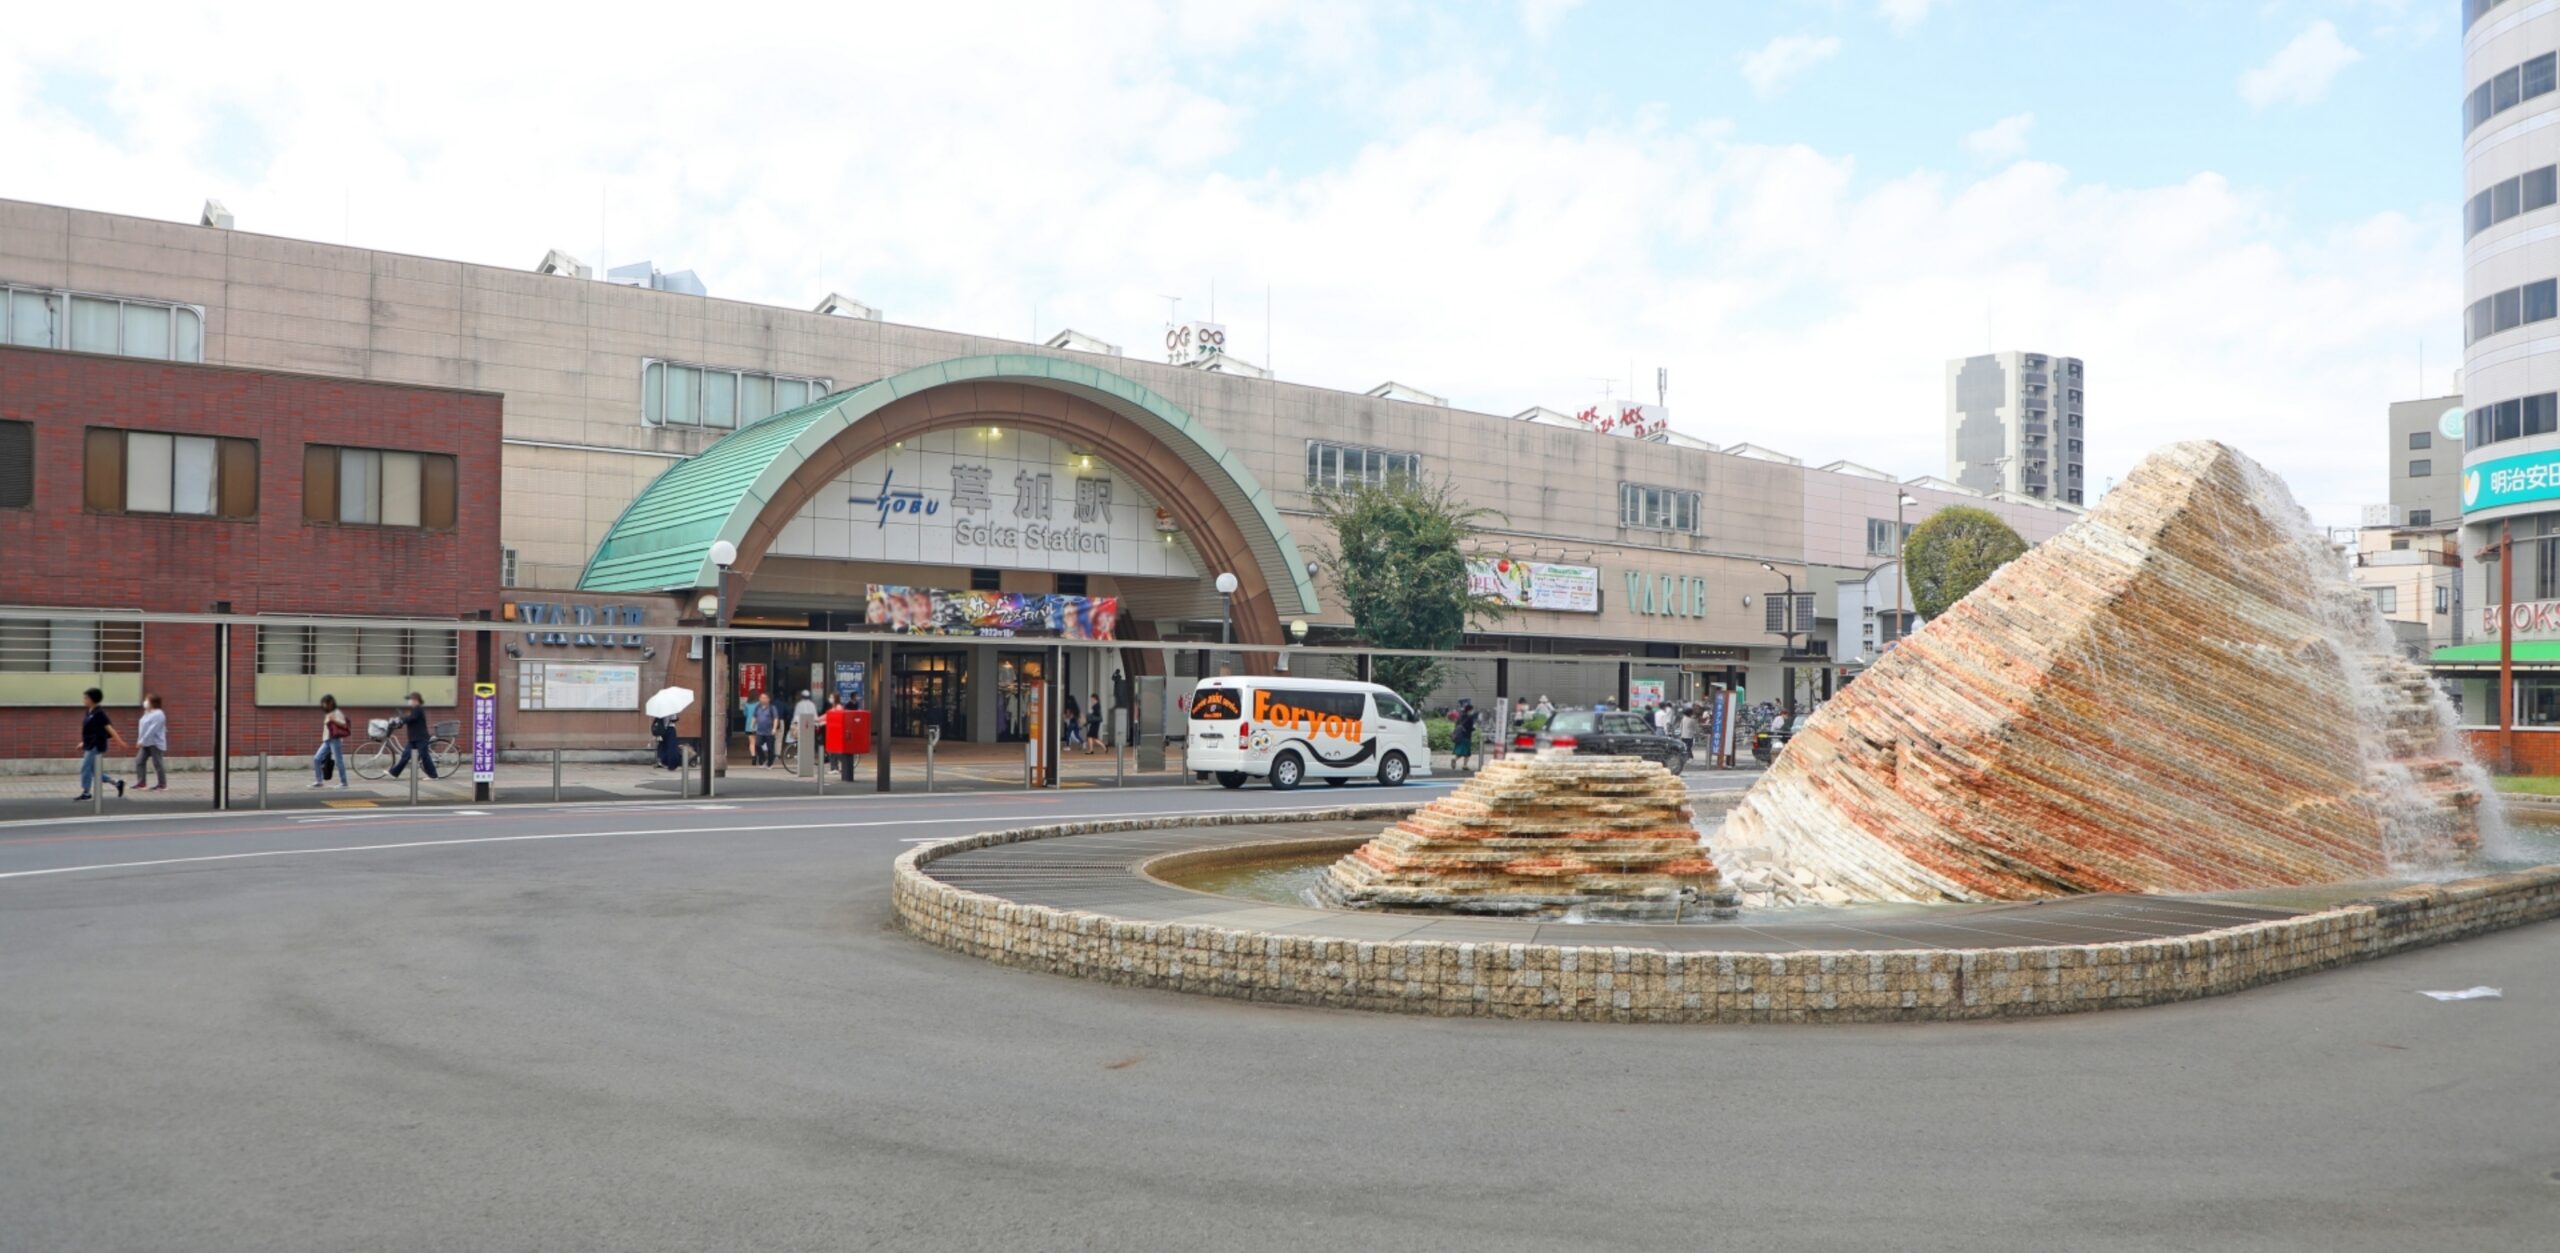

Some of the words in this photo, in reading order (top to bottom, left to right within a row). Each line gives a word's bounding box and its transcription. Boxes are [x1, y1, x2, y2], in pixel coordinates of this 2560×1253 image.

[950, 464, 1112, 524] 草加駅
[956, 518, 1019, 548] Soka
[1024, 523, 1109, 554] Station
[1624, 569, 1707, 619] VARIE
[518, 602, 643, 648] VARIE
[1254, 689, 1363, 743] Foryou
